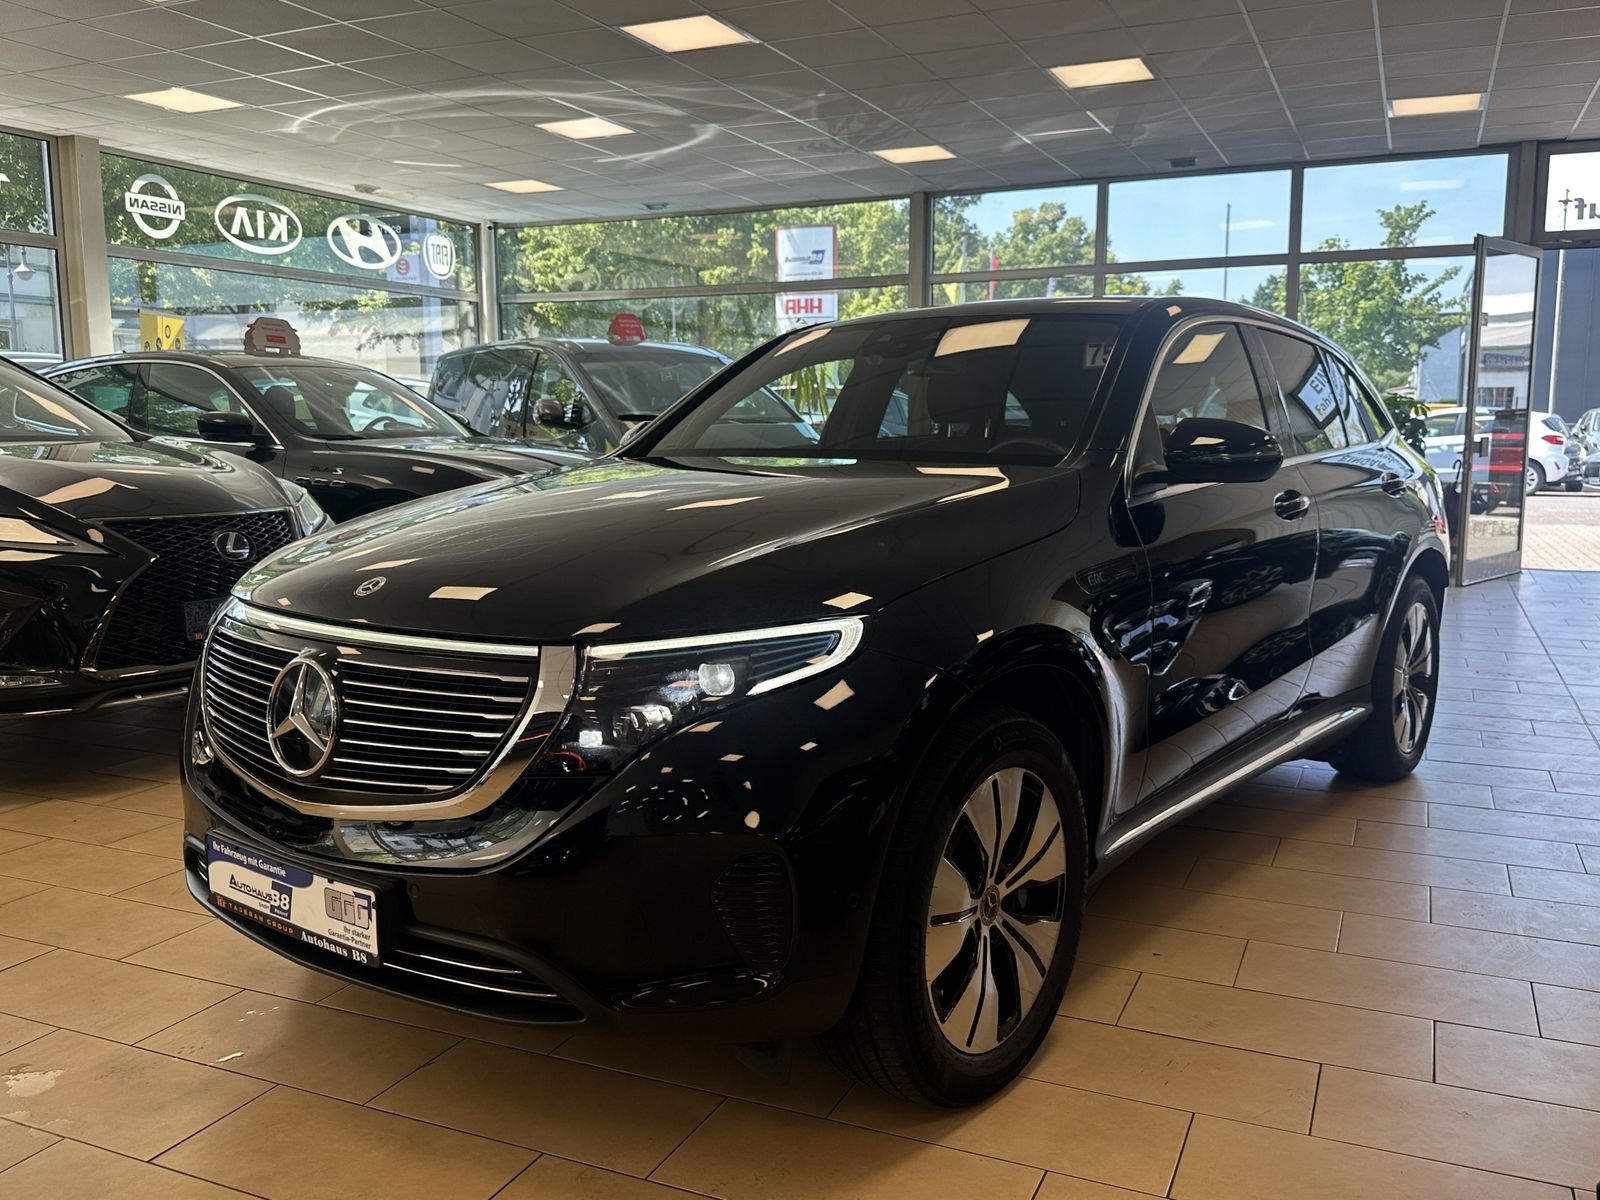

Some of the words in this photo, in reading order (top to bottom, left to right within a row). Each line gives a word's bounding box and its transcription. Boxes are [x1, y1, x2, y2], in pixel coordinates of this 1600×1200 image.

[784, 298, 823, 315] AHH
[212, 841, 221, 853] Ihr
[220, 844, 248, 865] Fahrzeug
[248, 856, 258, 868] mit
[258, 859, 287, 878] Garantie
[229, 873, 273, 902] AUTOHAUS
[266, 917, 294, 935] GROUP
[351, 929, 371, 941] starker
[300, 931, 348, 957] Autohaus
[352, 949, 368, 964] B8
